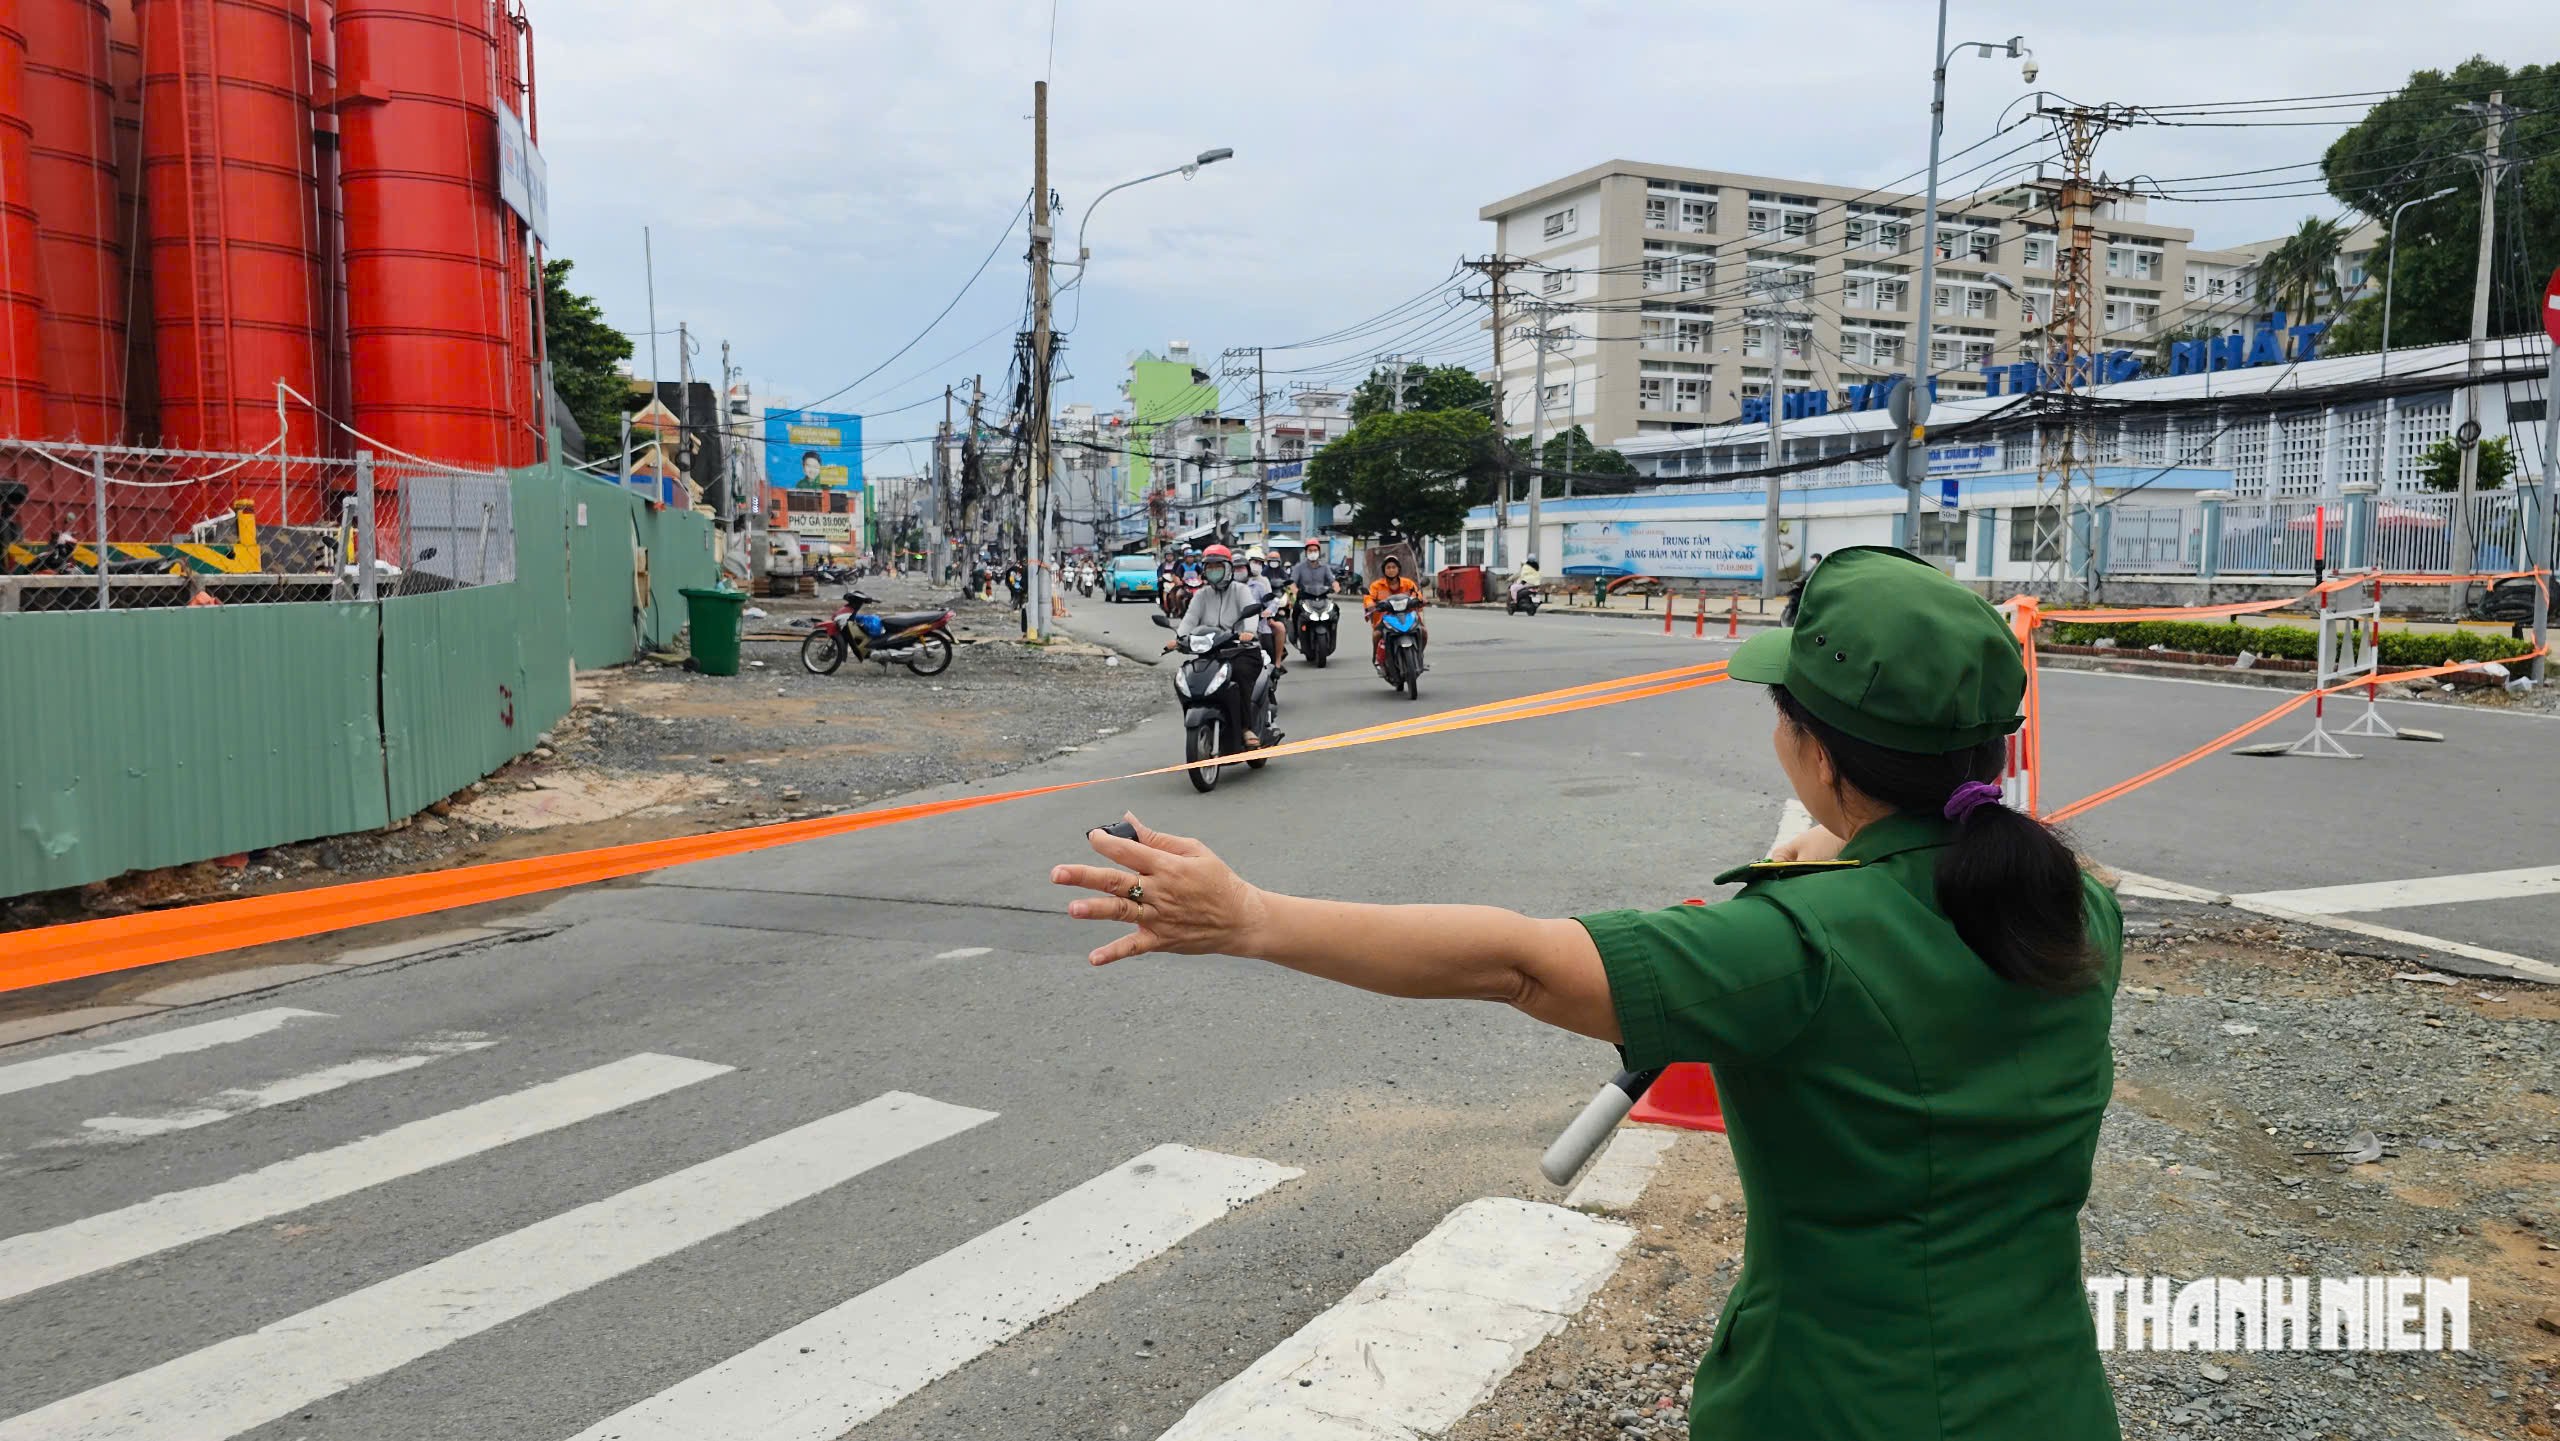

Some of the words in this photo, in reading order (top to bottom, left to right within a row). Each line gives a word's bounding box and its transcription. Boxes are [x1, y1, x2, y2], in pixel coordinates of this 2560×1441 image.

[2170, 312, 2326, 377] NHẤT
[1662, 536, 1690, 546] TRUNG
[1693, 534, 1711, 546] TÂM
